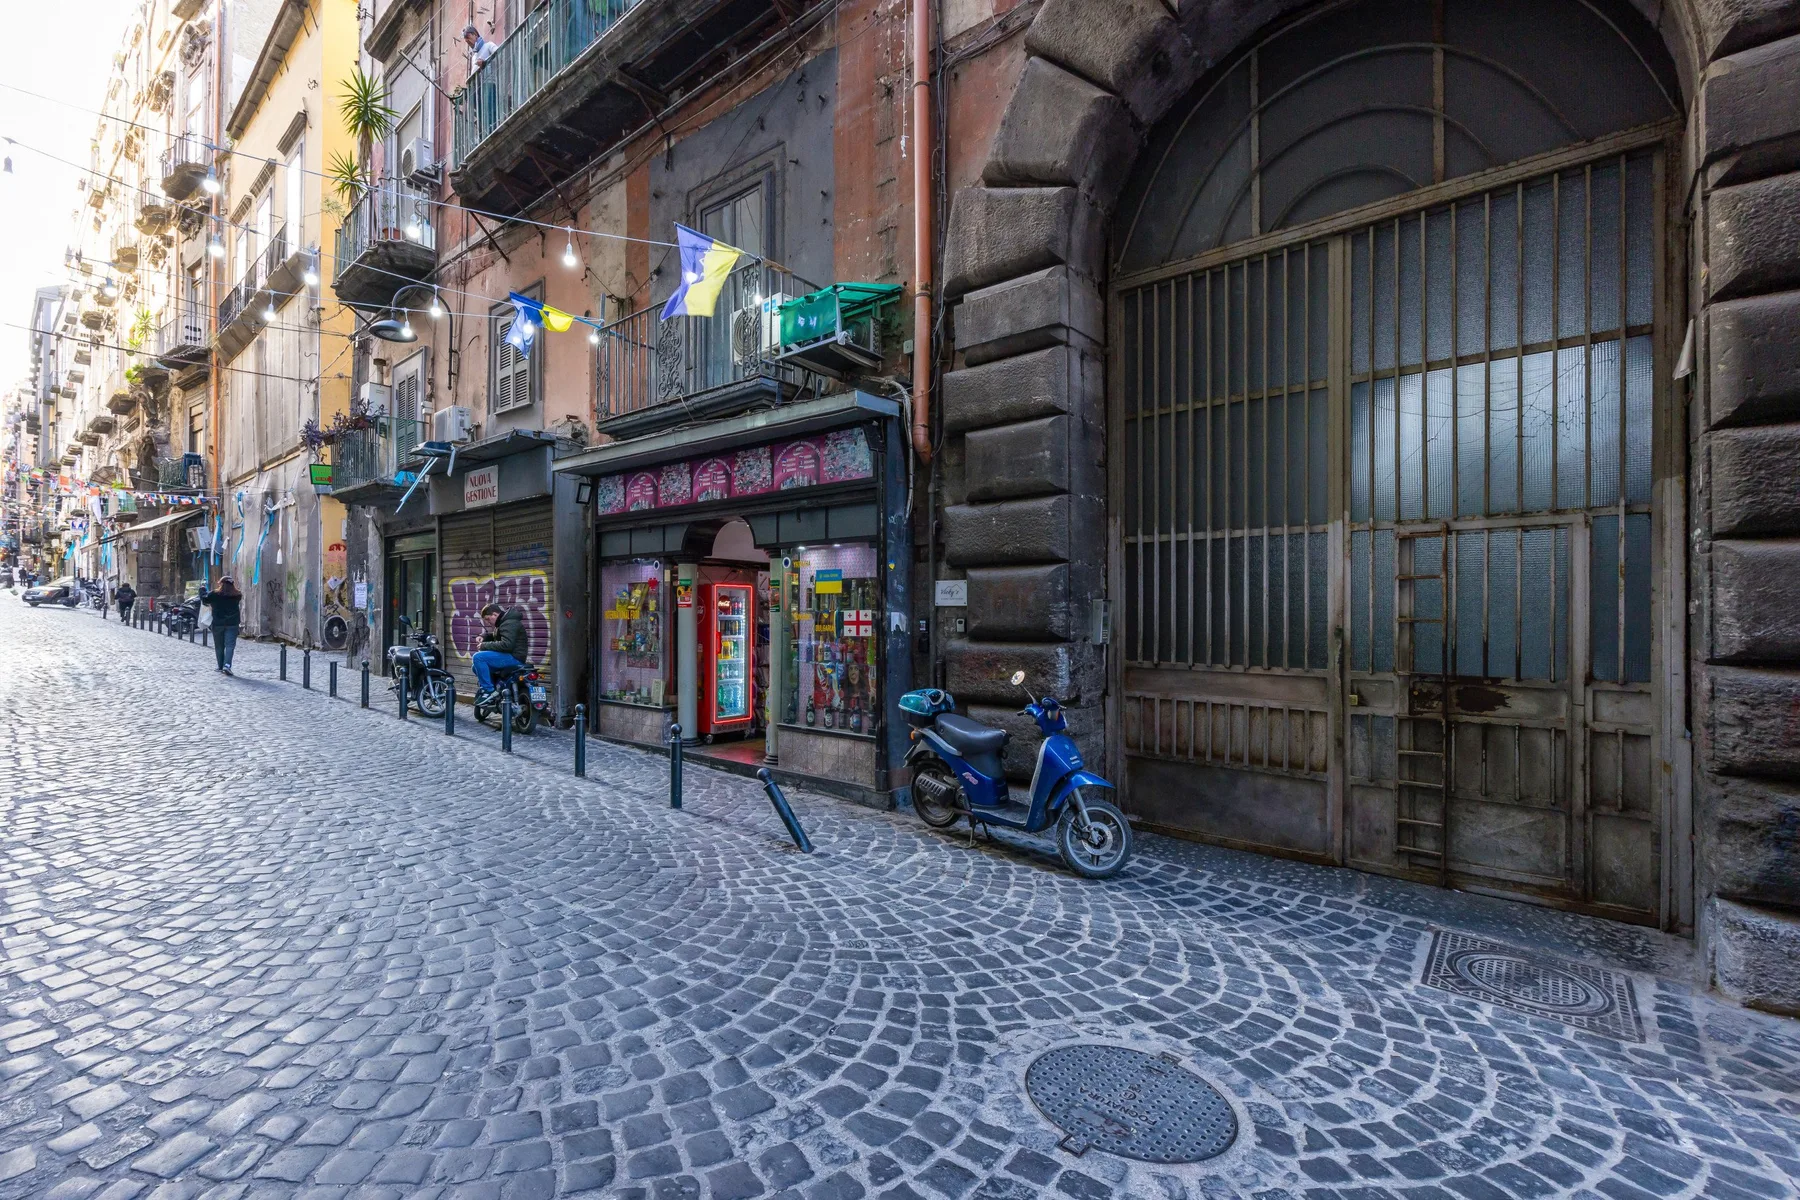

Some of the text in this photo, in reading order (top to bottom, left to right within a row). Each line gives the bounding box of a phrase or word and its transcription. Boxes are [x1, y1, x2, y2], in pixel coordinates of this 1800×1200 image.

[469, 472, 492, 487] NUOVA
[465, 485, 497, 503] GESTIONE
[1078, 1086, 1158, 1126] FOGNATURA
